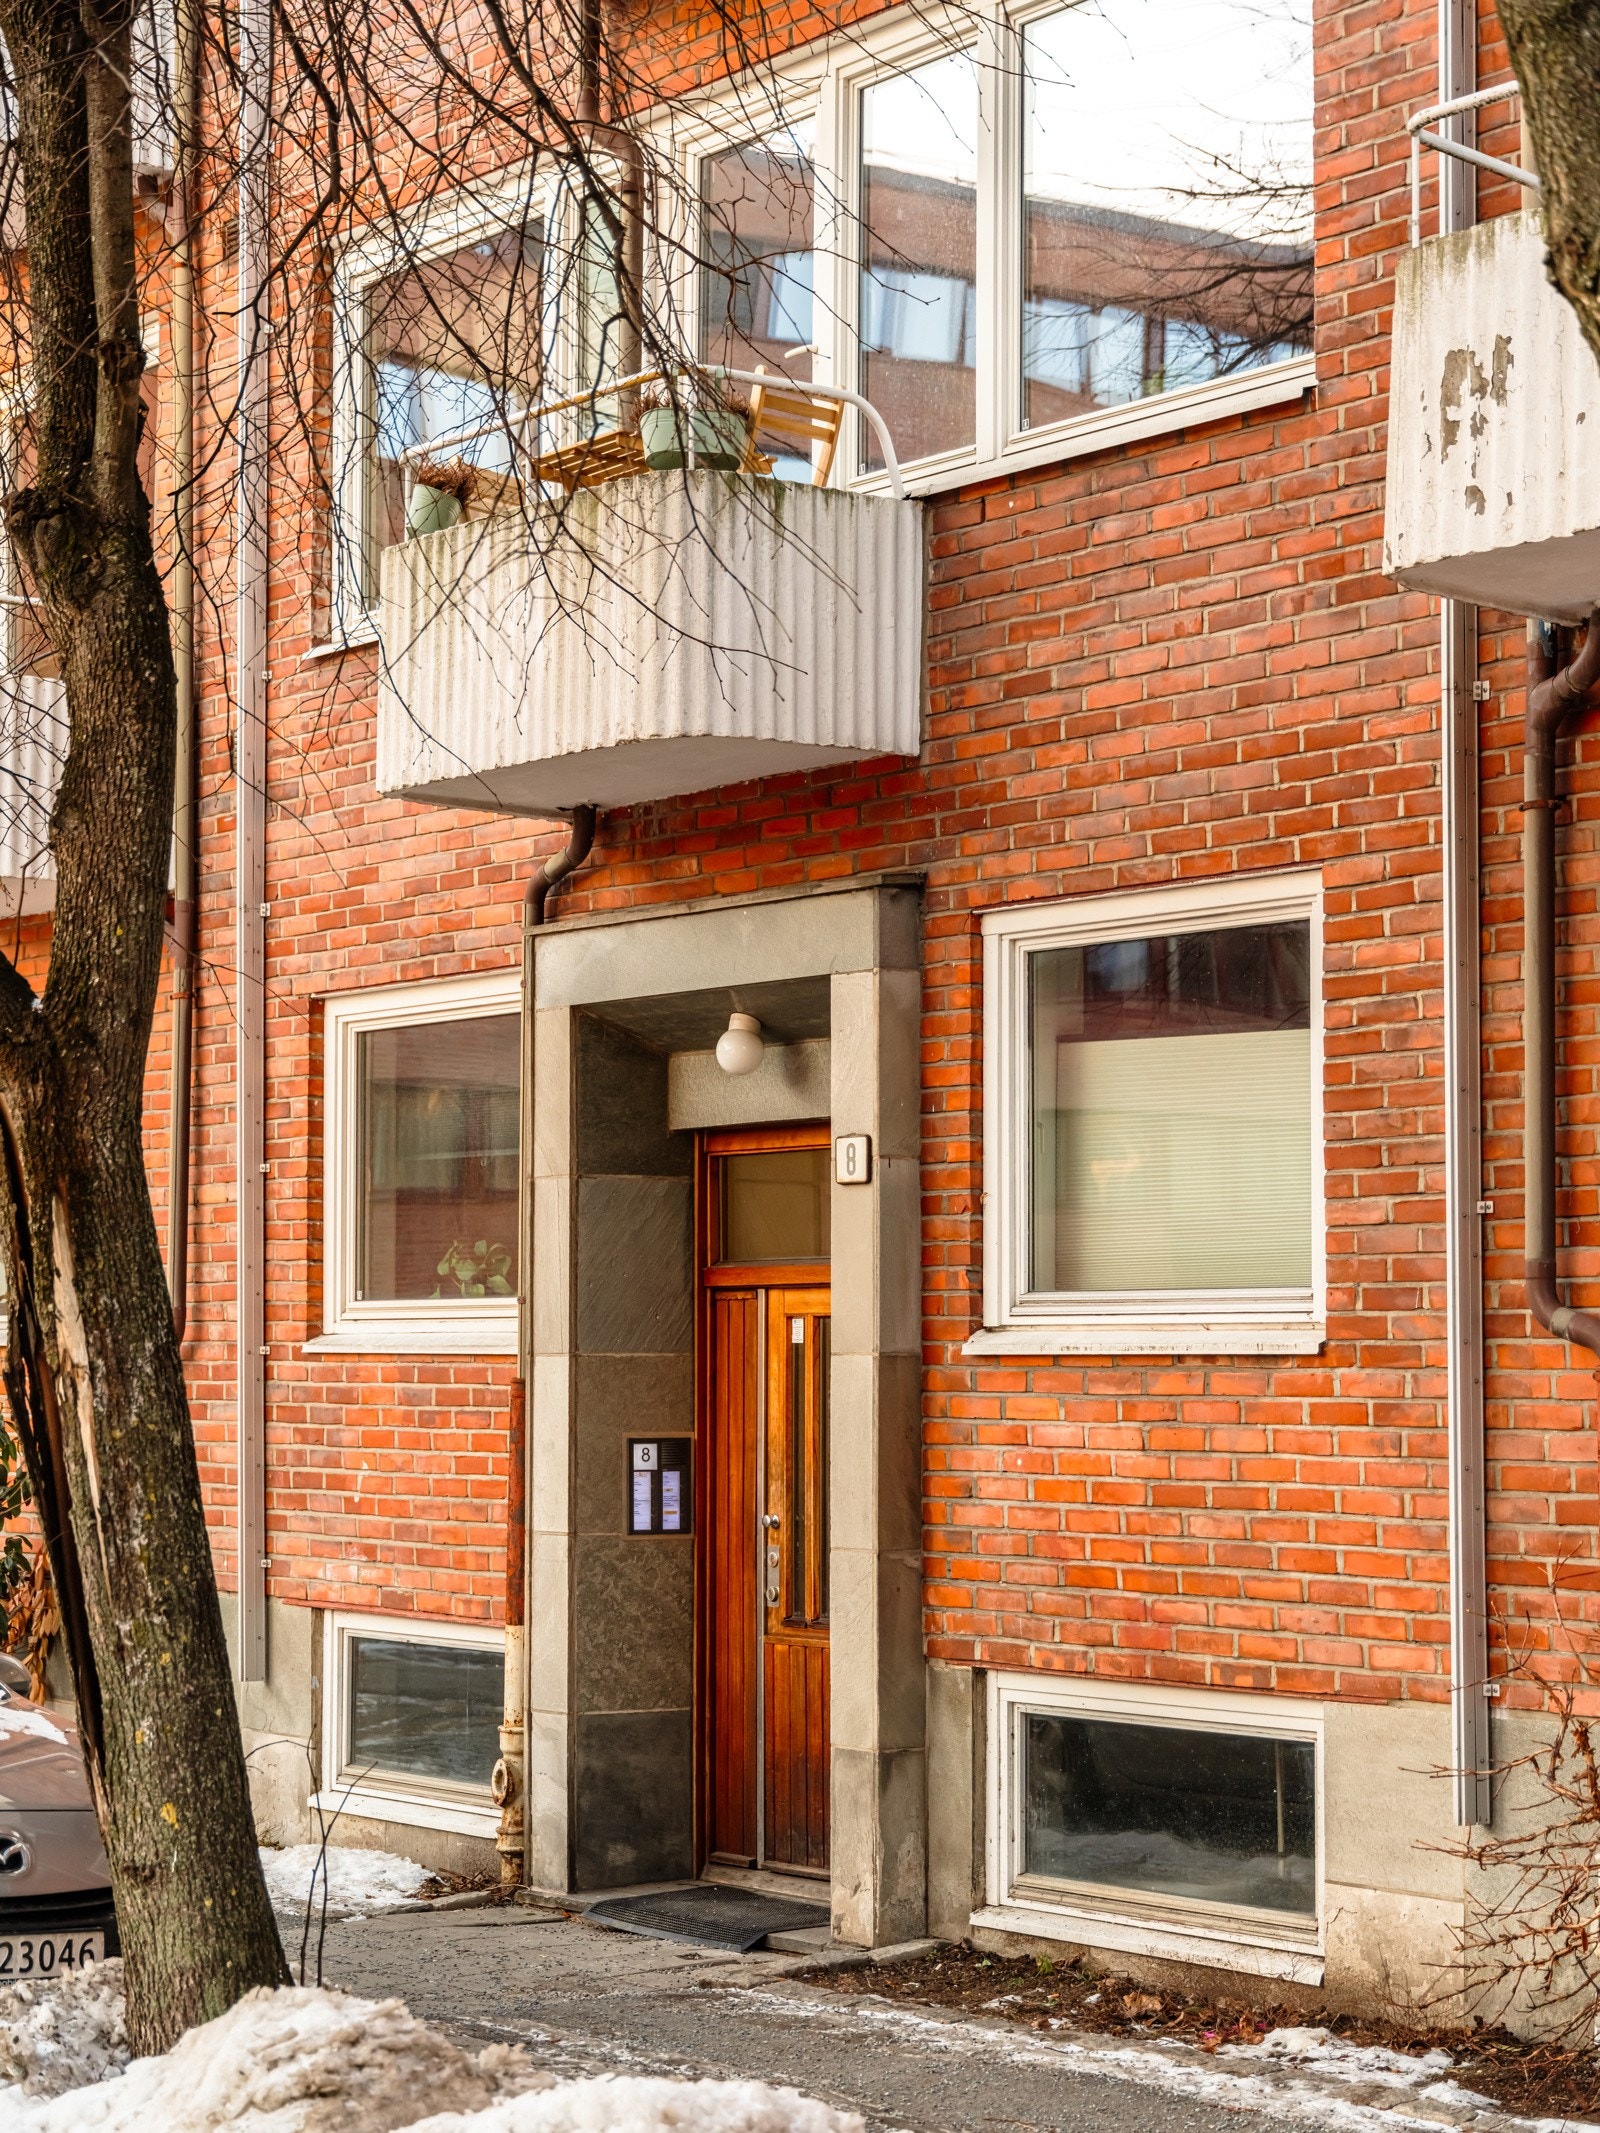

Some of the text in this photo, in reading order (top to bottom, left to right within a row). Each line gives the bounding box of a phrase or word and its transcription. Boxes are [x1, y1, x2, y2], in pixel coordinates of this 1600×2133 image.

[846, 1142, 856, 1176] 8
[641, 1447, 651, 1462] 8
[0, 1938, 95, 1973] 23046
